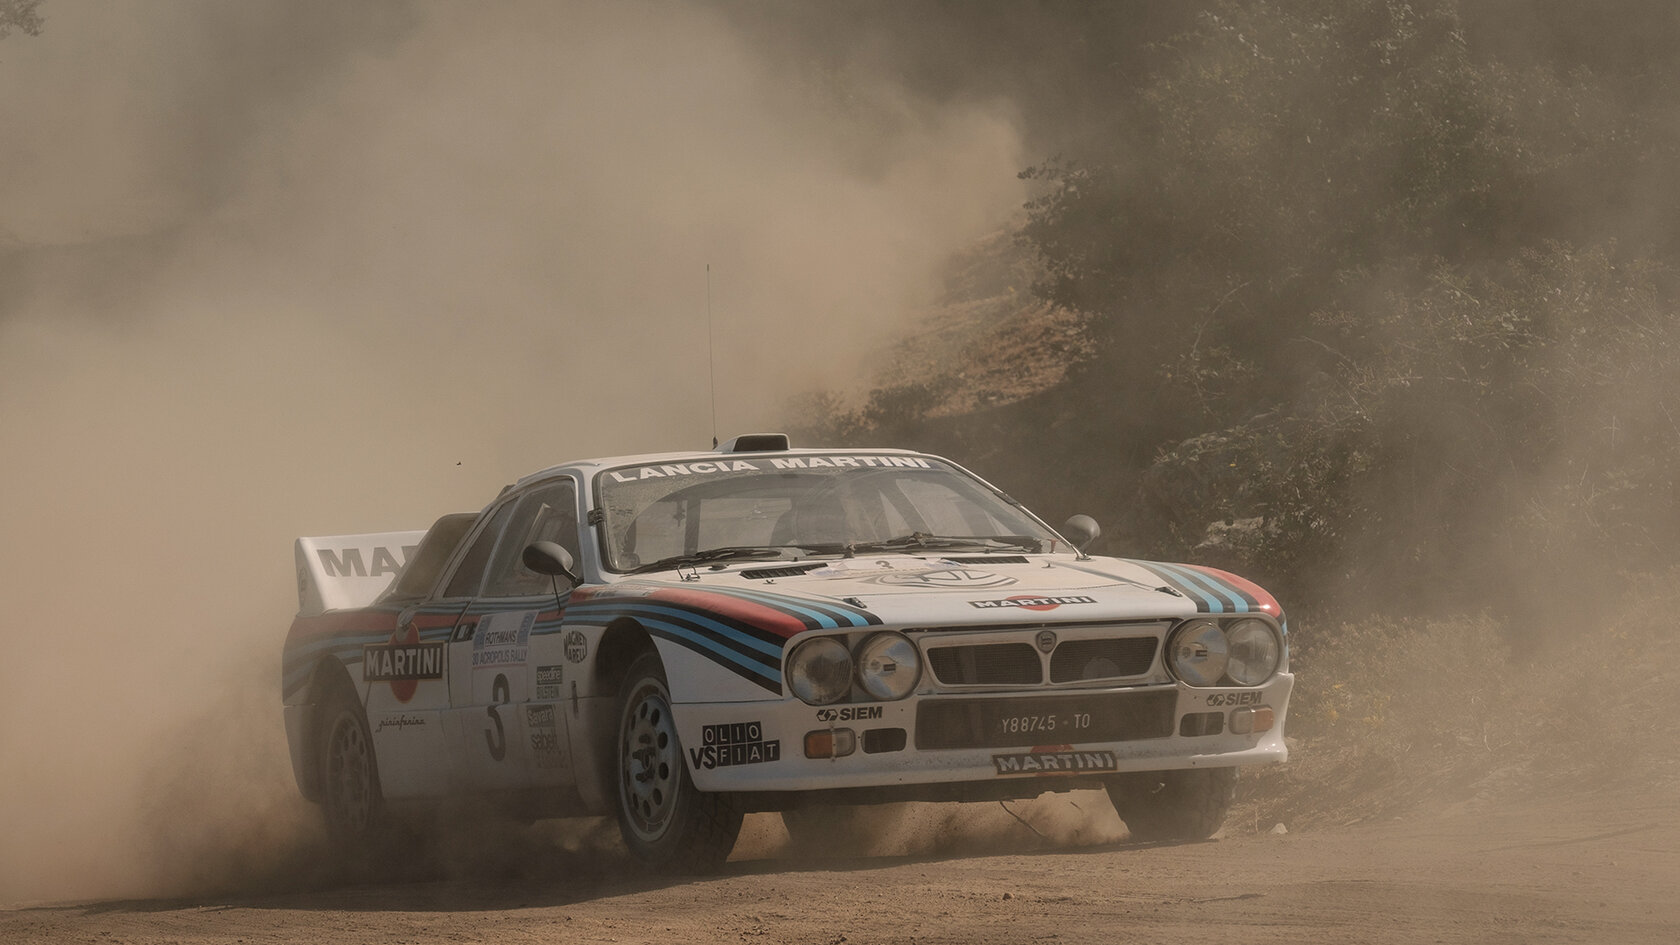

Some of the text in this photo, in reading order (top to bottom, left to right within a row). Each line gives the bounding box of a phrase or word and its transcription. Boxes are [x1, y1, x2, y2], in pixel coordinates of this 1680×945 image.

[609, 456, 932, 483] LANCIA MARTINI
[875, 560, 894, 570] 3
[974, 595, 1093, 609] MARTINI
[485, 630, 517, 645] ROTHMANS
[366, 647, 441, 677] MARTINI
[479, 649, 510, 665] ACROPOLIS
[510, 648, 528, 662] RALLY
[1225, 691, 1264, 706] SIEM
[484, 673, 511, 762] 3
[839, 706, 883, 721] SIEM
[375, 714, 426, 733] pininfarina
[1001, 713, 1090, 734] Y88745 TO
[704, 724, 760, 744] OLIO
[690, 743, 777, 770] VS FIAT
[997, 752, 1114, 773] MARTINI
